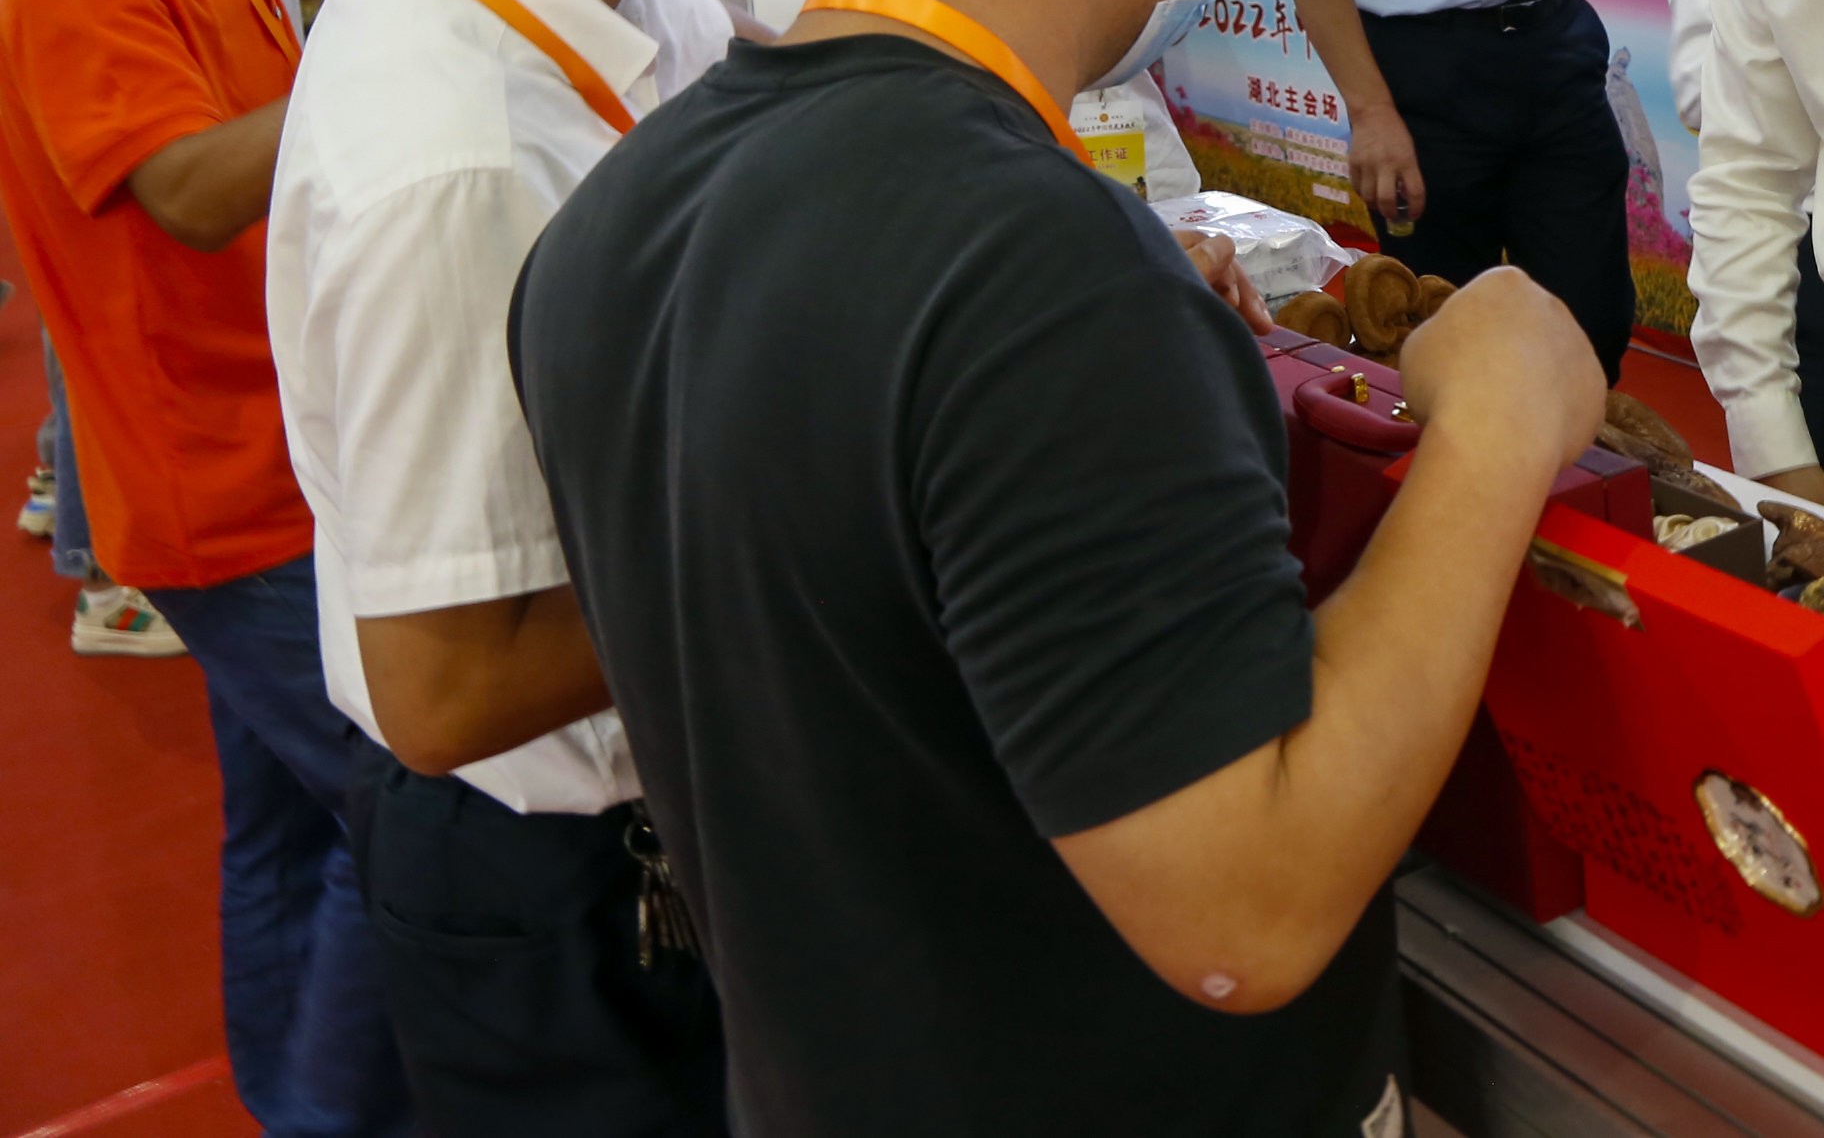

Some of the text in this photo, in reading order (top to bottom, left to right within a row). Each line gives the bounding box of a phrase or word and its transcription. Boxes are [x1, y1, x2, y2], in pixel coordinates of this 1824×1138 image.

[1247, 75, 1338, 122] 湖北主会场
